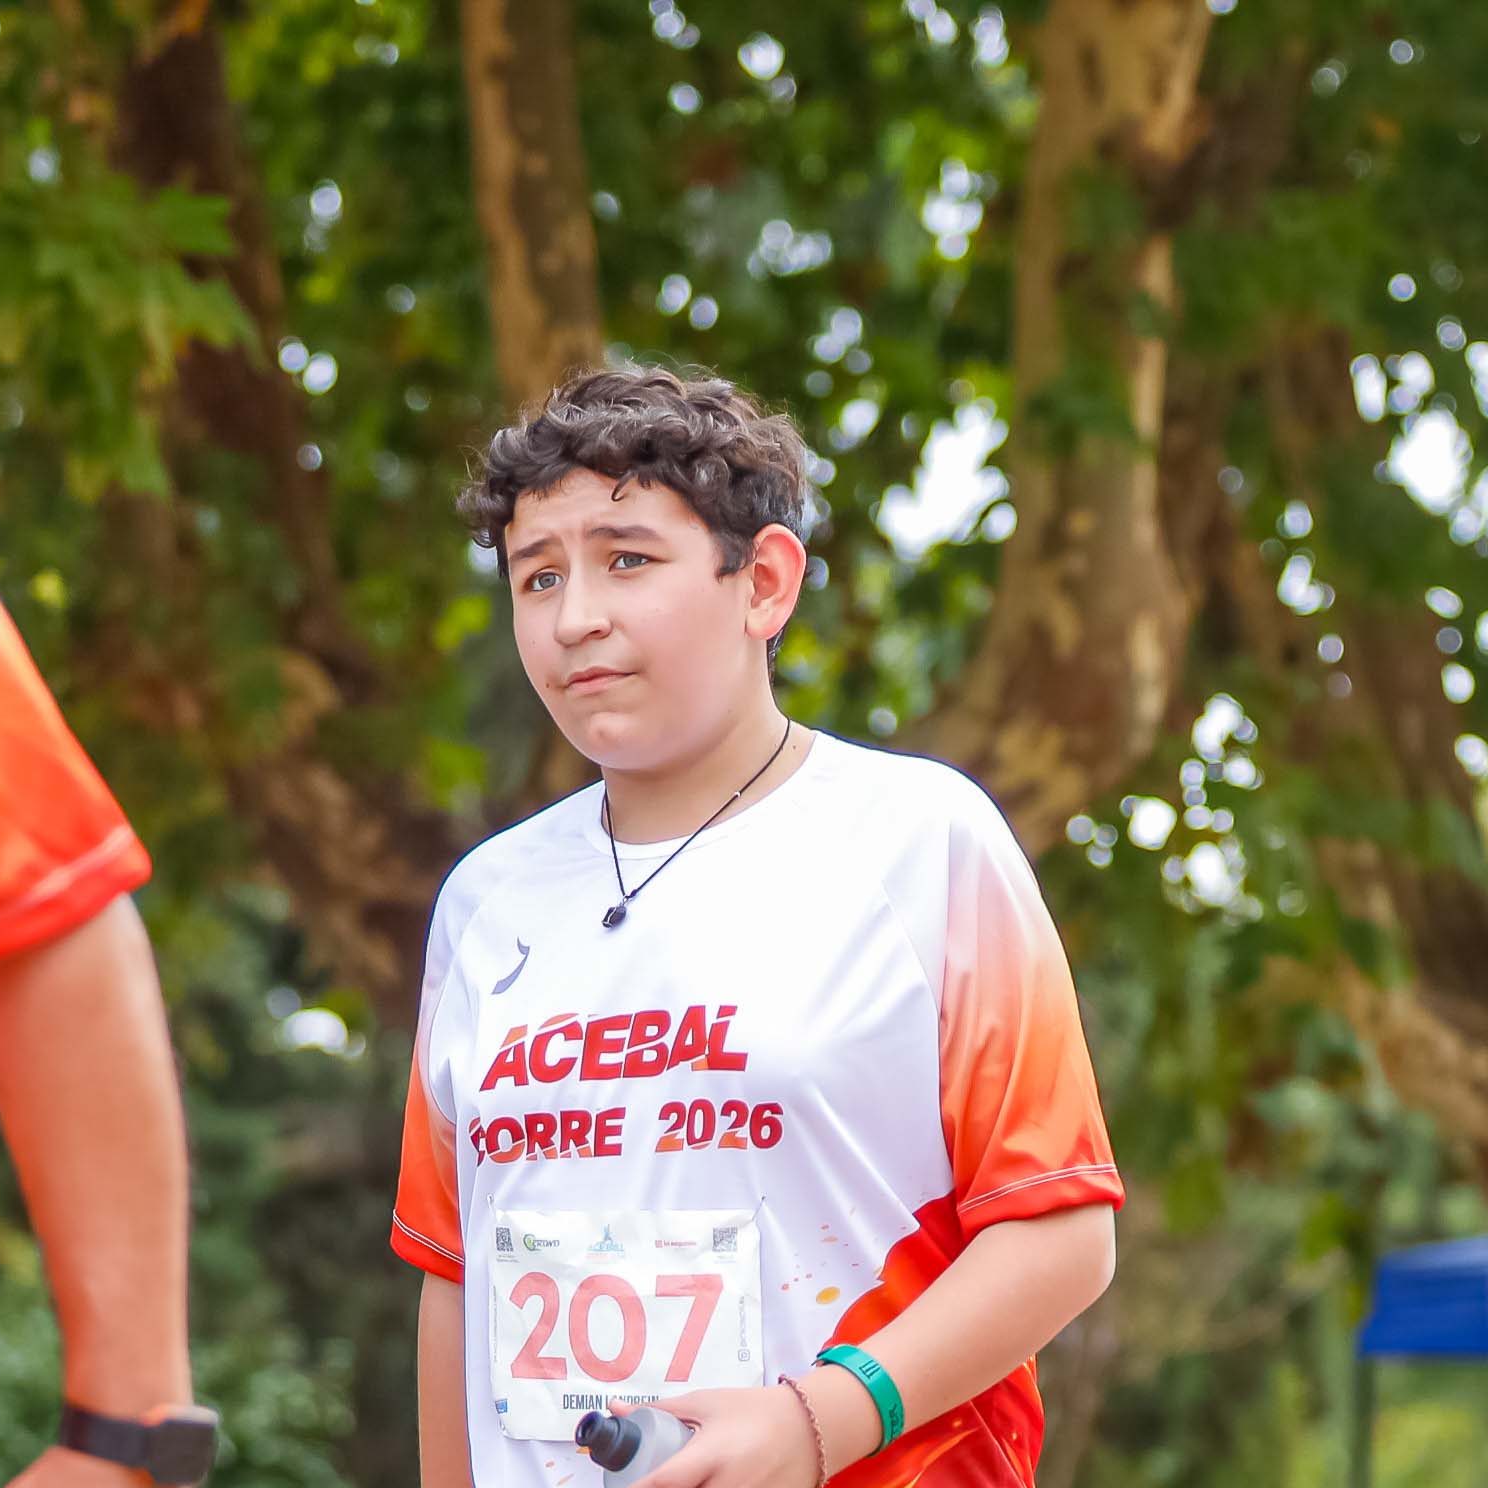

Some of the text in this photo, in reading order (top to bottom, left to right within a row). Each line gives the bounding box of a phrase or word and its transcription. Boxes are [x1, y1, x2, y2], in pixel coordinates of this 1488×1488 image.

[478, 1004, 749, 1092] ACEBAL
[655, 1099, 784, 1155] 2026
[508, 1271, 724, 1384] 207
[563, 1393, 603, 1410] DEMIAN
